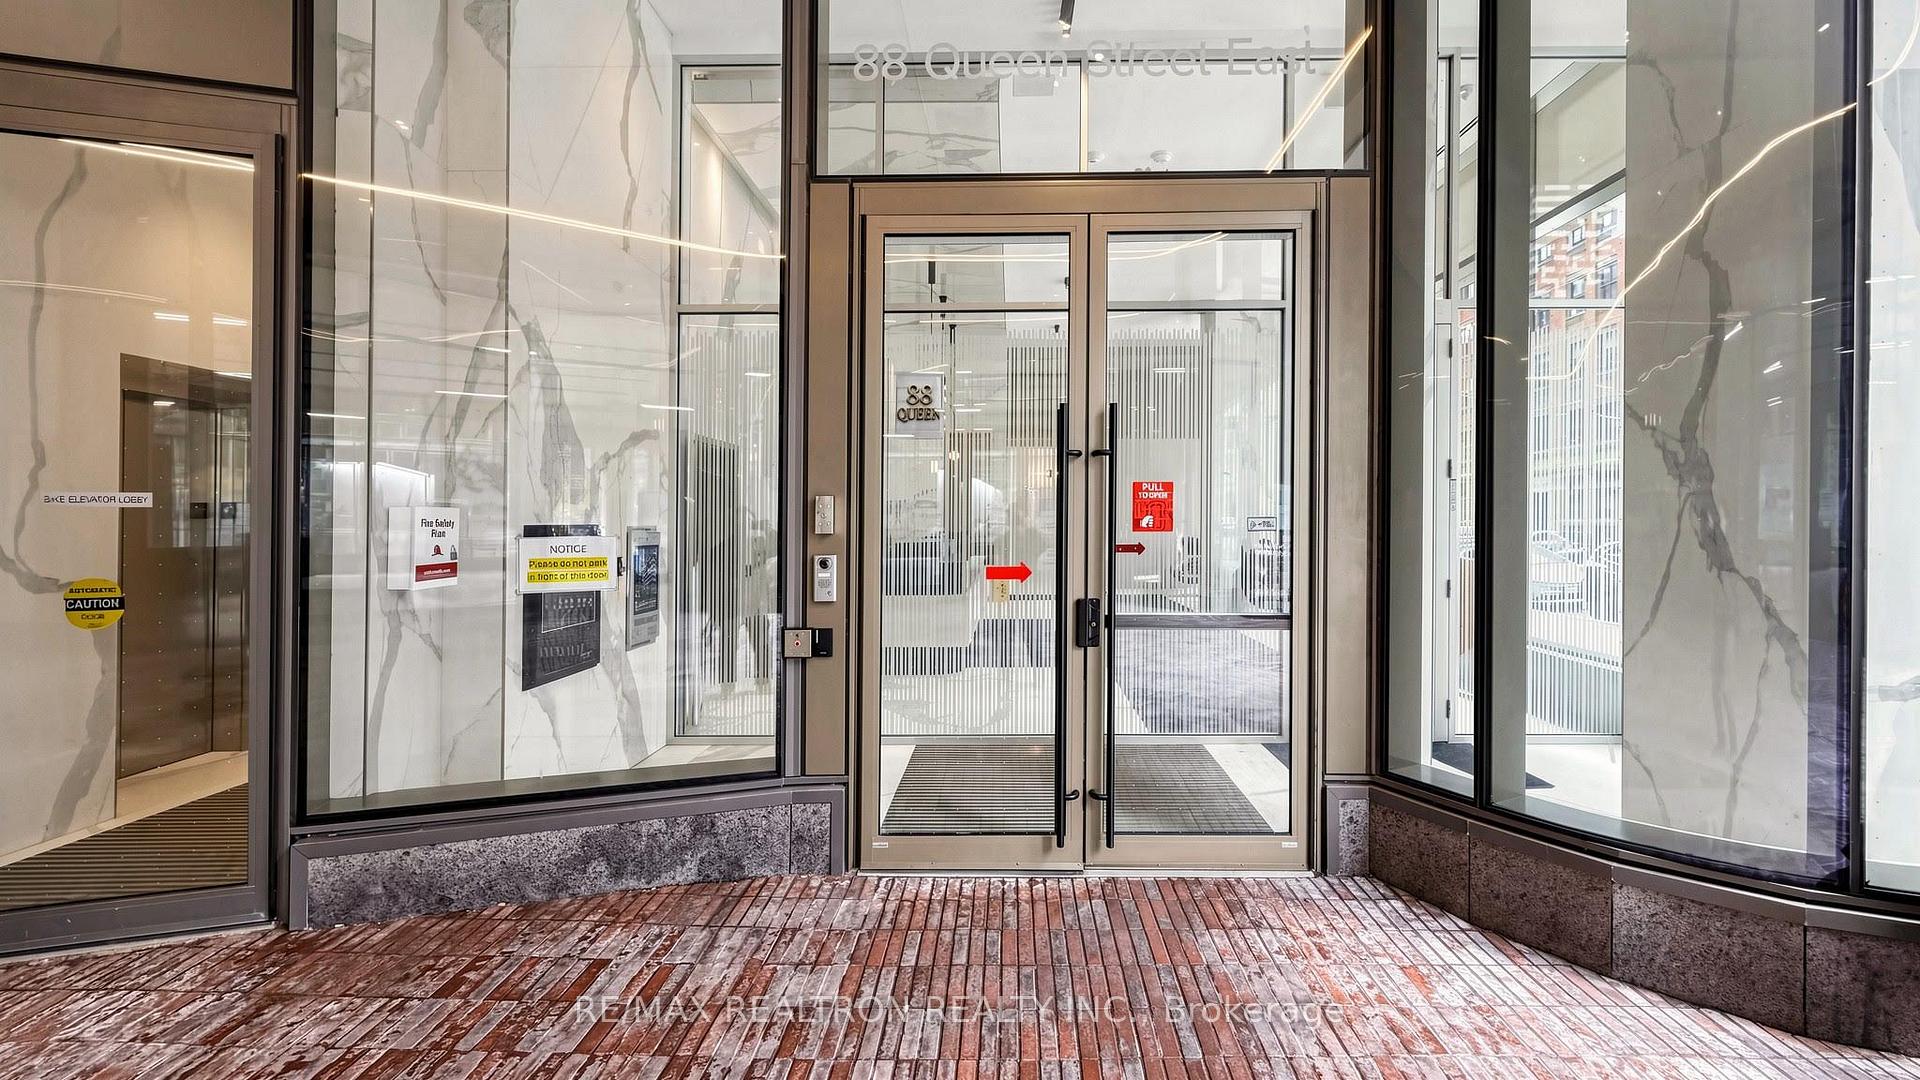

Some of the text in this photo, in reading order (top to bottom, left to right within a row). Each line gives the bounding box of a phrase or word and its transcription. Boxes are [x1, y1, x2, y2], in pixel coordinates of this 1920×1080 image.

[853, 37, 1316, 82] 88 Queen Street East
[897, 408, 940, 423] QUEEN
[1142, 483, 1163, 491] PULL
[68, 495, 116, 504] ELEVATOR
[118, 495, 149, 504] LOBBY
[549, 545, 588, 554] NOTICE
[66, 598, 120, 609] CAUTION
